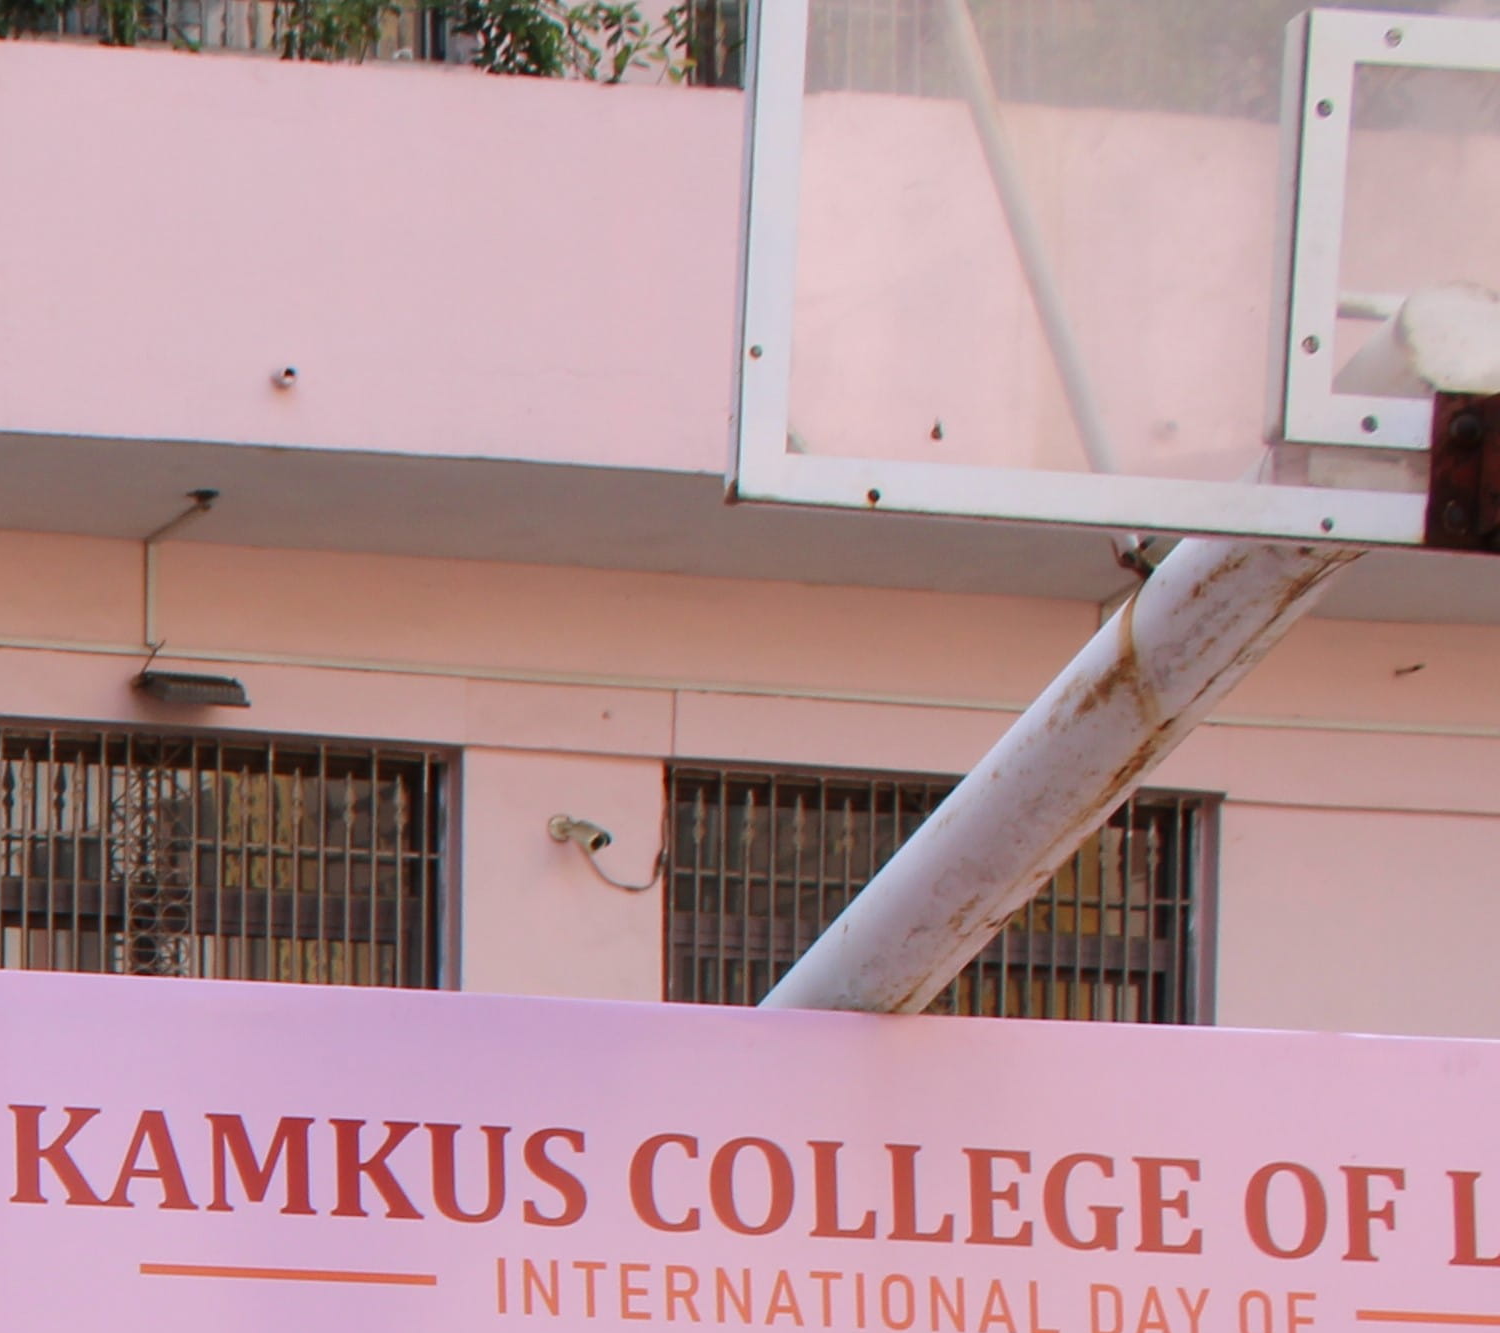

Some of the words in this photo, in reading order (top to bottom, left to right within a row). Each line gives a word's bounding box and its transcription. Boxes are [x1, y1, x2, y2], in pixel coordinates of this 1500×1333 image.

[7, 1103, 588, 1229] KAMKUS
[628, 1132, 1203, 1256] COLLEGE
[1244, 1161, 1406, 1263] OF
